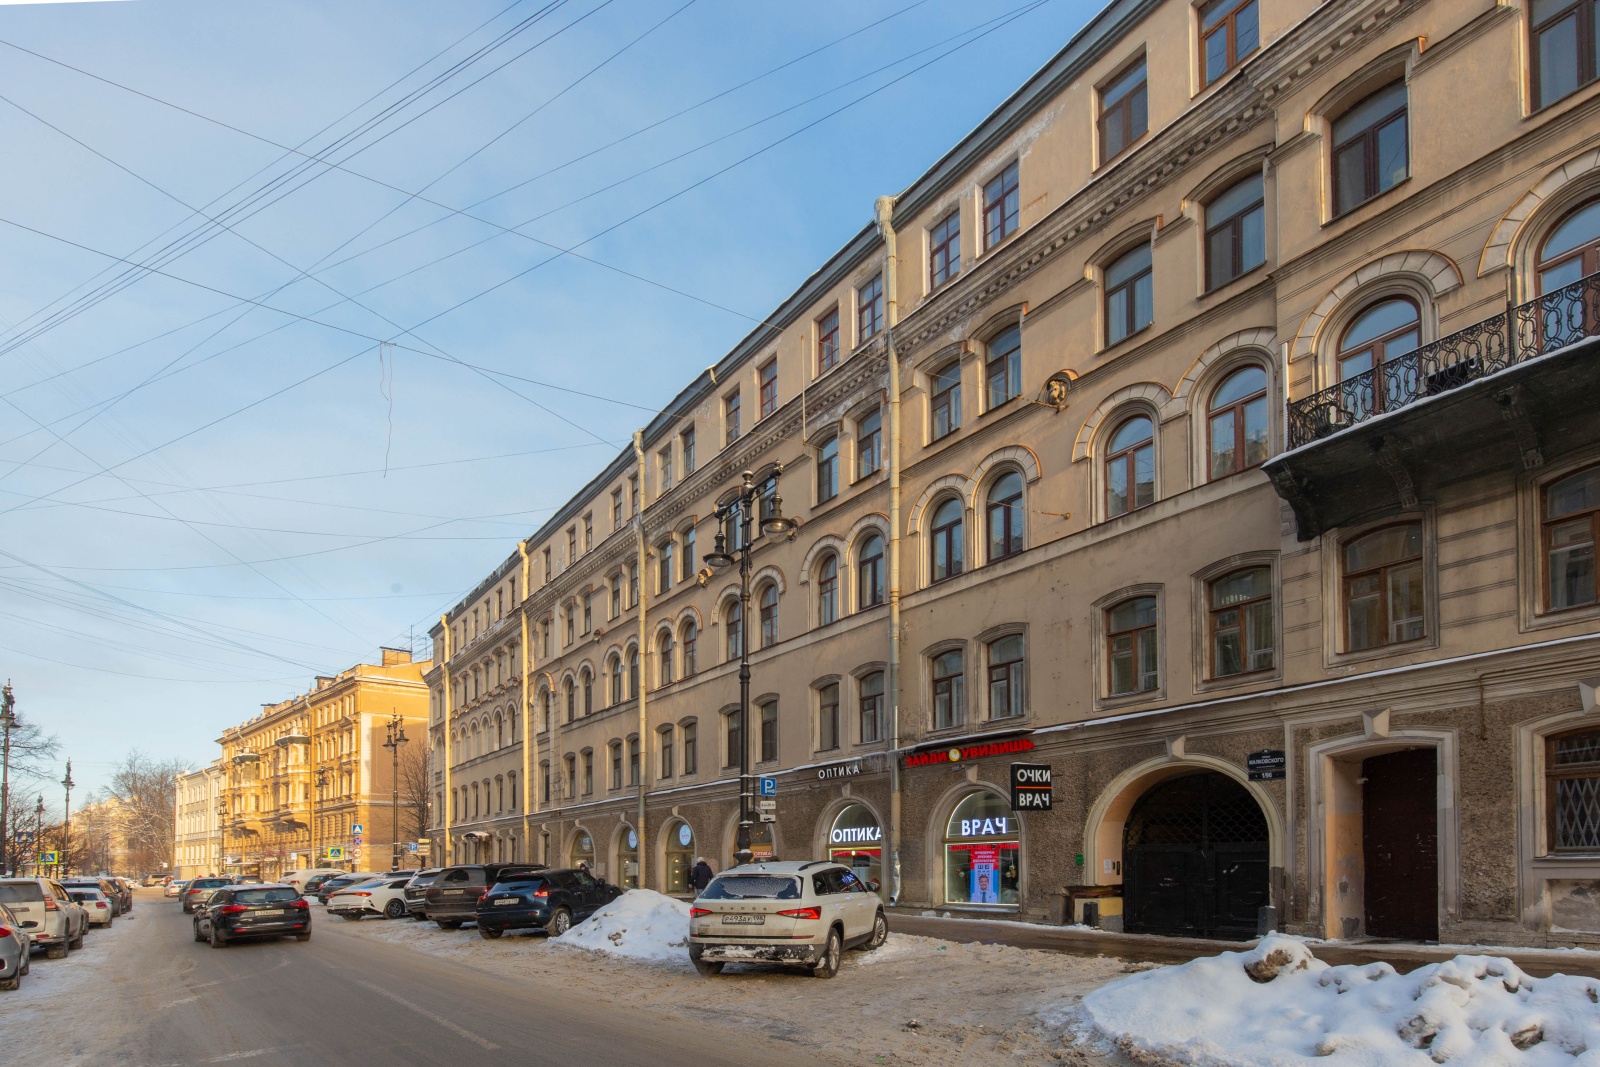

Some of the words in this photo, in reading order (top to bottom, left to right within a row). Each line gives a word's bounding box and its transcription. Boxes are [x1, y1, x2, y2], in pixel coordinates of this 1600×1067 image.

[906, 751, 948, 767] ЗАЙДИ
[961, 739, 1034, 758] УВИДИШЬ
[1249, 757, 1284, 765] МАЯКОВСКОГО
[818, 766, 860, 779] ОПТИКА
[1017, 769, 1051, 783] ОЧКИ
[1019, 793, 1050, 808] ВРАЧ
[832, 826, 882, 842] ОПТИКА
[961, 817, 1007, 836] ВРАЧ
